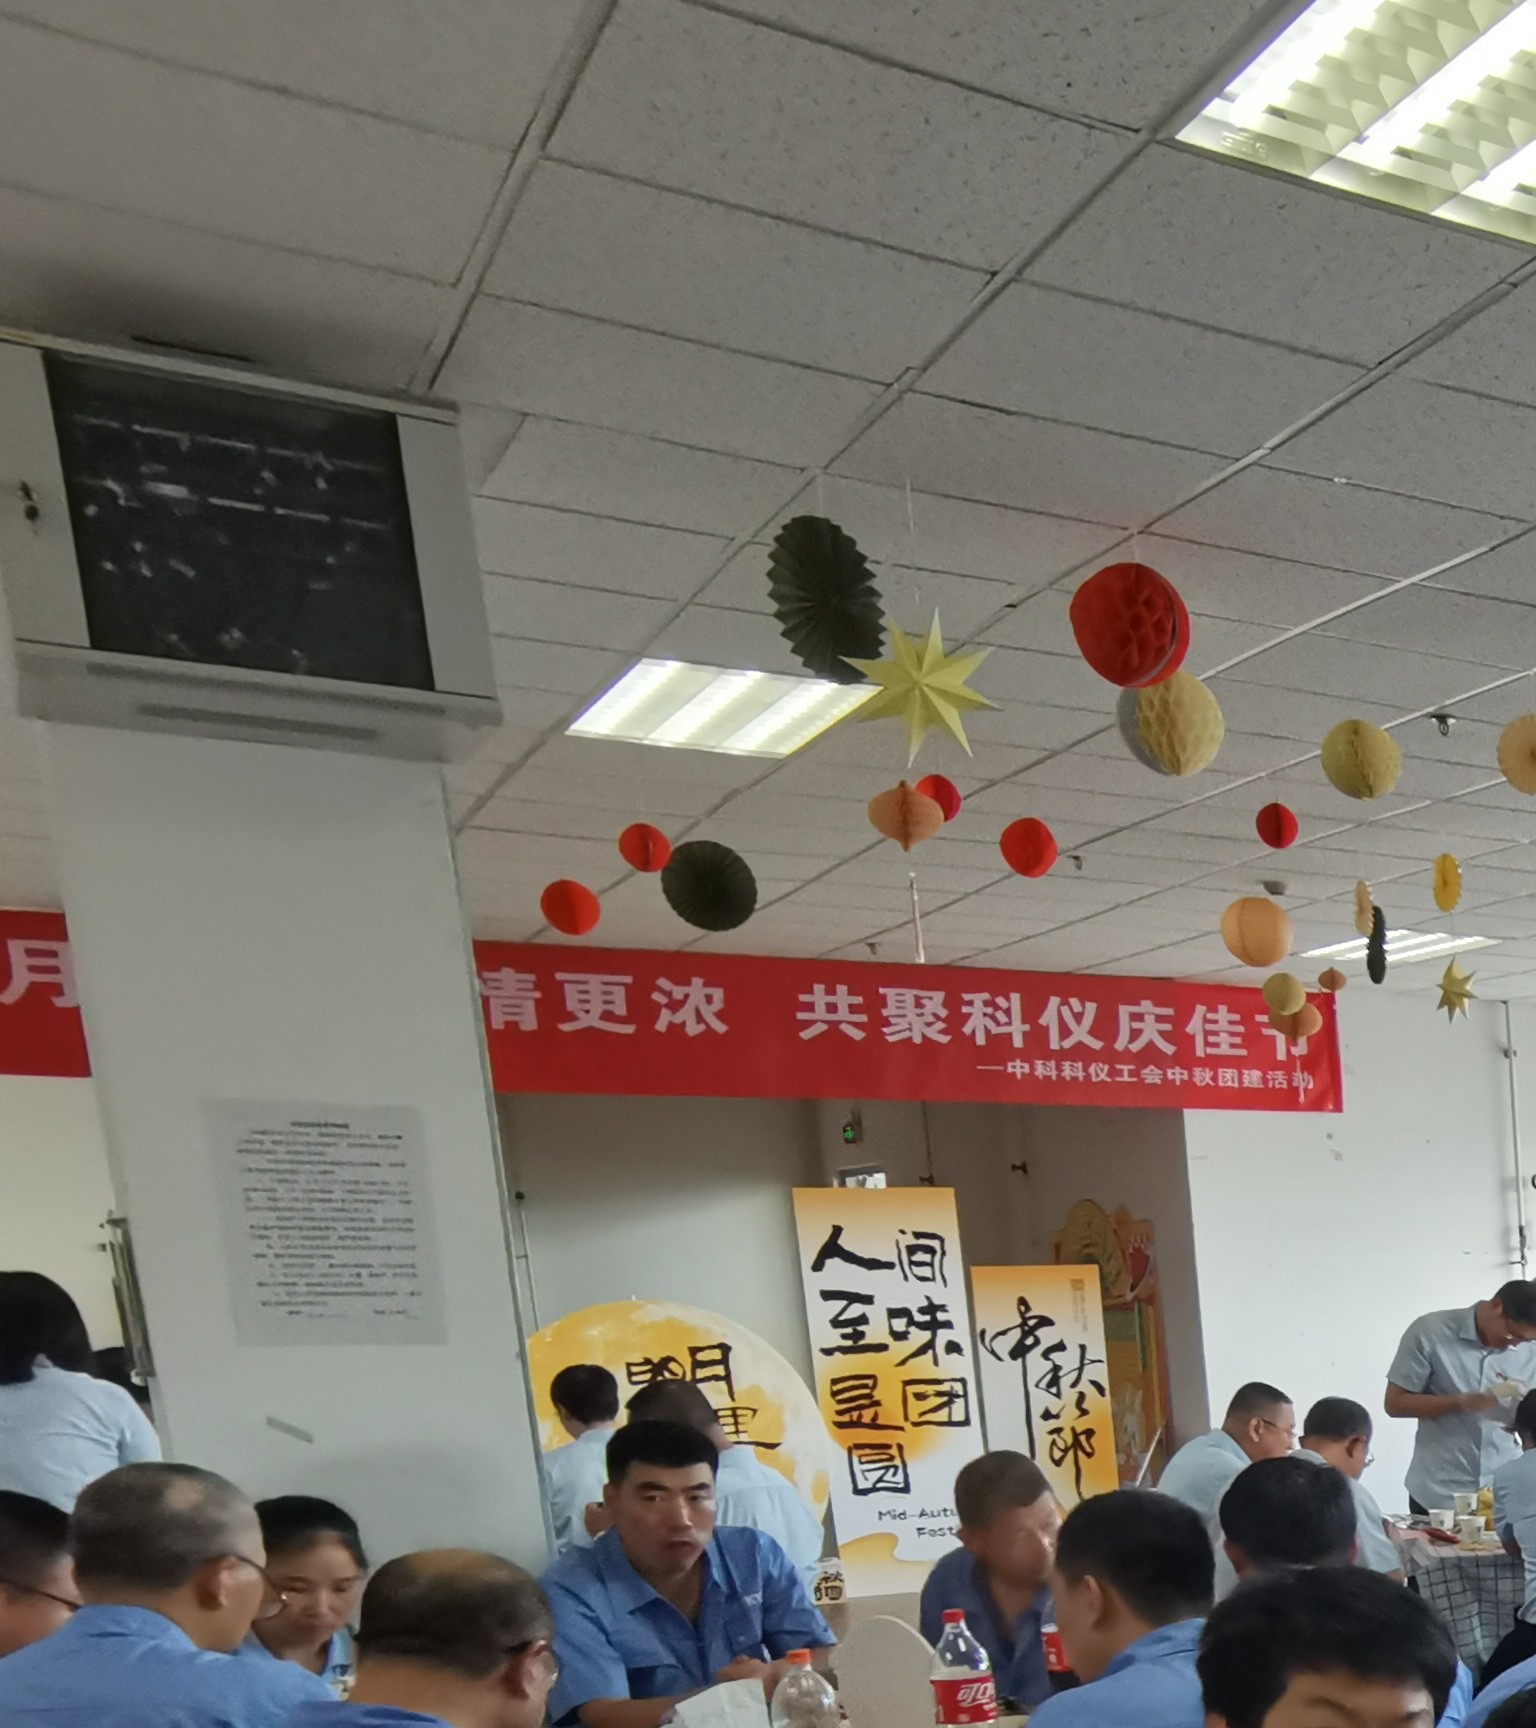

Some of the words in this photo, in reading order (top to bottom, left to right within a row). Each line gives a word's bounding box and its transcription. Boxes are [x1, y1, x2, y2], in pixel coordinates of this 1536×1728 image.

[0, 938, 81, 1008] 月
[811, 1224, 947, 1287] 人间
[819, 1289, 964, 1367] 至味
[830, 1374, 971, 1432] 是团
[848, 1442, 911, 1496] 圆
